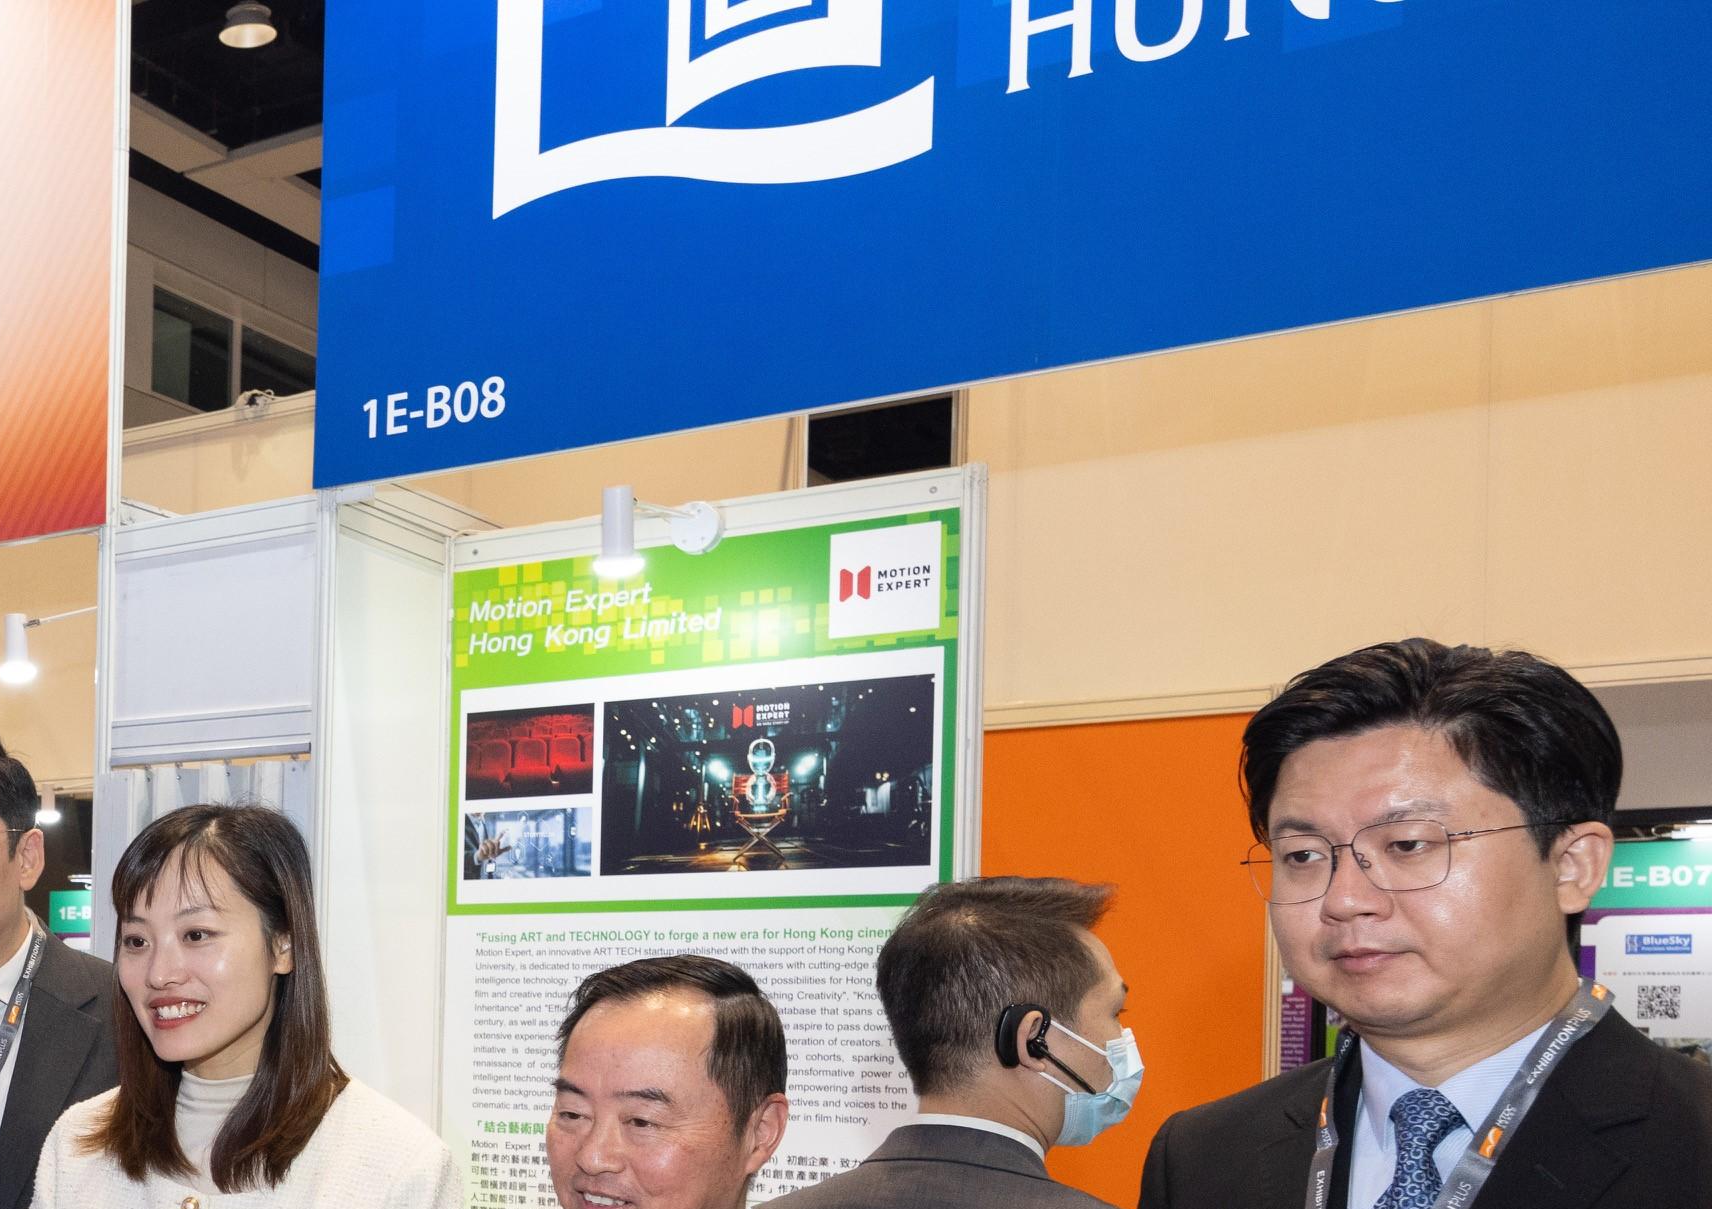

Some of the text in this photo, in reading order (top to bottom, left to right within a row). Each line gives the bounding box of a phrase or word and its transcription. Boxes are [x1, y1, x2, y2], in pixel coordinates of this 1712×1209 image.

[363, 375, 506, 439] 1E-B08
[877, 564, 931, 579] MOTION
[877, 578, 930, 592] EXPERT
[469, 582, 653, 623] Motion Expert
[469, 607, 723, 657] Hong Kong Limited
[756, 702, 790, 712] MOTION
[756, 711, 790, 720] EXPERT
[59, 905, 92, 920] 1E-B
[520, 932, 543, 942] ART
[546, 932, 566, 942] and
[570, 930, 651, 942] TECHNOLOGY
[654, 931, 665, 941] to
[668, 929, 699, 943] forge
[702, 931, 710, 940] a
[713, 931, 736, 940] new
[740, 931, 759, 940] era
[763, 928, 779, 940] for
[783, 928, 816, 942] Hong
[820, 928, 854, 941] Kong
[857, 927, 894, 940] cinem
[1642, 935, 1690, 947] BlueSky
[475, 948, 503, 957] Motion
[504, 948, 533, 958] Expert,
[535, 949, 546, 957] an
[549, 947, 592, 957] innovative
[593, 947, 612, 956] ART
[615, 947, 641, 956] TECH
[643, 947, 674, 957] startup
[676, 945, 728, 956] established
[731, 945, 749, 955] with
[751, 945, 766, 955] the
[768, 945, 803, 956] support
[804, 944, 817, 954] of
[819, 944, 845, 956] Hong
[847, 944, 874, 956] Kong
[475, 962, 518, 972] University,
[519, 962, 527, 971] is
[529, 962, 570, 971] dedicated
[571, 962, 580, 971] to
[786, 961, 806, 970] with
[808, 960, 869, 972] cutting-edge
[475, 975, 520, 986] intelligence
[771, 976, 826, 987] possibilities
[829, 976, 842, 985] for
[845, 976, 872, 987] Hong
[474, 989, 489, 999] film
[491, 990, 507, 999] and
[509, 990, 542, 999] creative
[525, 1004, 542, 1013] and
[777, 1007, 817, 1016] atabase
[820, 1007, 839, 1016] that
[842, 1008, 873, 1018] spans
[520, 1018, 537, 1027] well
[793, 1023, 823, 1032] aspire
[825, 1023, 834, 1031] to
[837, 1024, 861, 1033] pass
[473, 1032, 512, 1041] extensive
[514, 1033, 559, 1042] experienc
[785, 1039, 825, 1047] neration
[827, 1038, 837, 1047] of
[473, 1045, 895, 1065] initiative is designe cohorts, sparking
[472, 1060, 522, 1069] renaissance
[527, 1061, 536, 1069] of
[788, 1068, 855, 1078] ransformative
[861, 1069, 893, 1079] power
[898, 1069, 909, 1079] of
[472, 1073, 512, 1083] intelligent
[788, 1083, 848, 1095] empowering
[851, 1085, 881, 1094] artists
[884, 1086, 908, 1095] from
[472, 1087, 502, 1096] diverse
[823, 1099, 841, 1108] and
[844, 1100, 876, 1109] voices
[878, 1101, 888, 1109] to
[891, 1101, 907, 1110] the
[472, 1101, 511, 1110] cinematic
[803, 1113, 812, 1122] in
[815, 1112, 832, 1122] film
[835, 1113, 871, 1126] history.
[477, 1120, 545, 1135] 「結合藝術與
[471, 1140, 498, 1149] Motion
[505, 1141, 531, 1151] Expert
